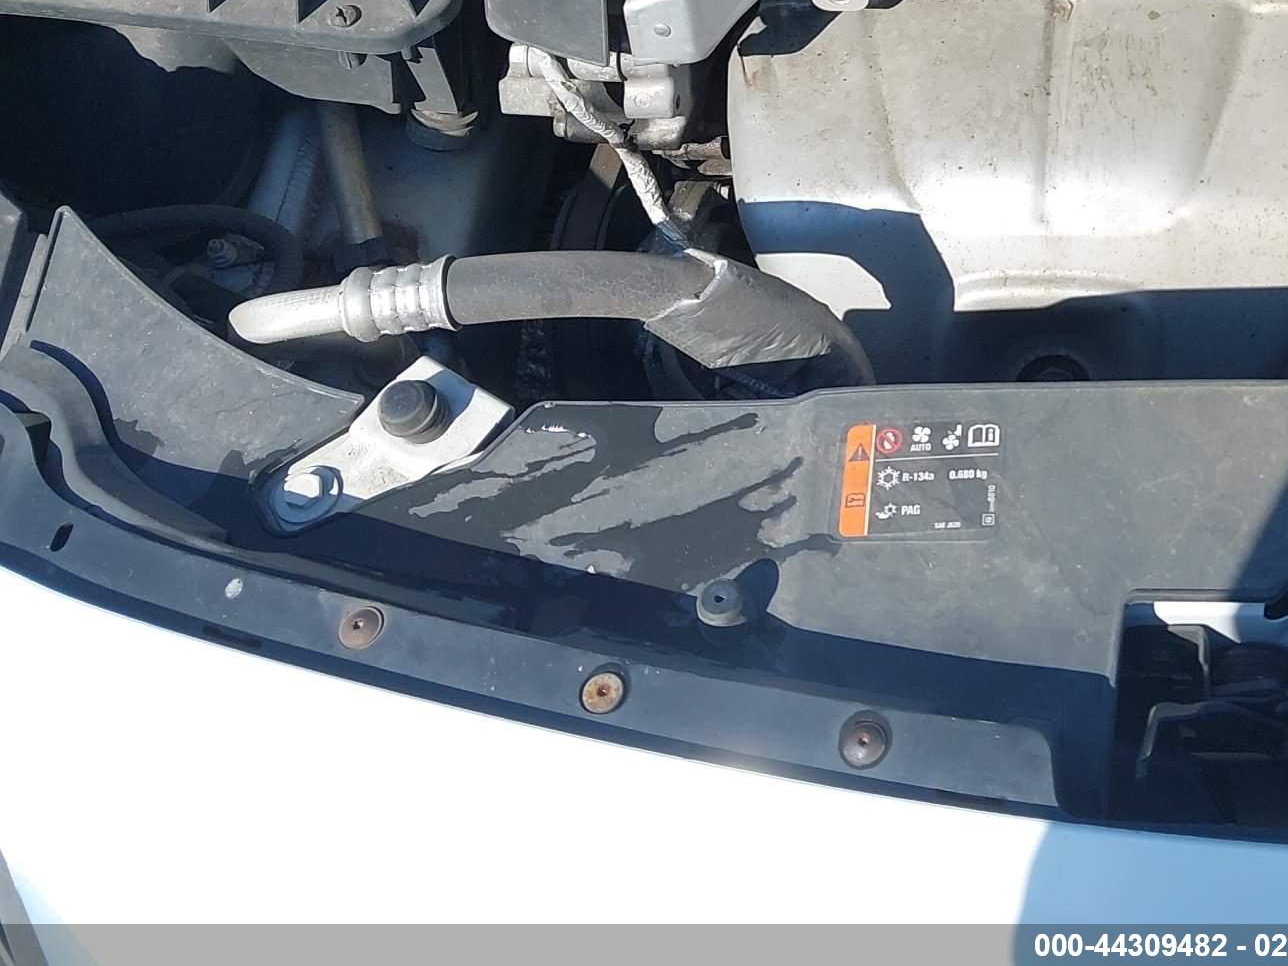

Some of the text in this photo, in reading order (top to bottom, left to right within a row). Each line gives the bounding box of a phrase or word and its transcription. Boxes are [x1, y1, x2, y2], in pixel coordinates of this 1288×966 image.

[910, 443, 932, 451] AUTO
[902, 471, 935, 481] R-134a
[976, 468, 988, 480] kg
[901, 505, 920, 515] PAG
